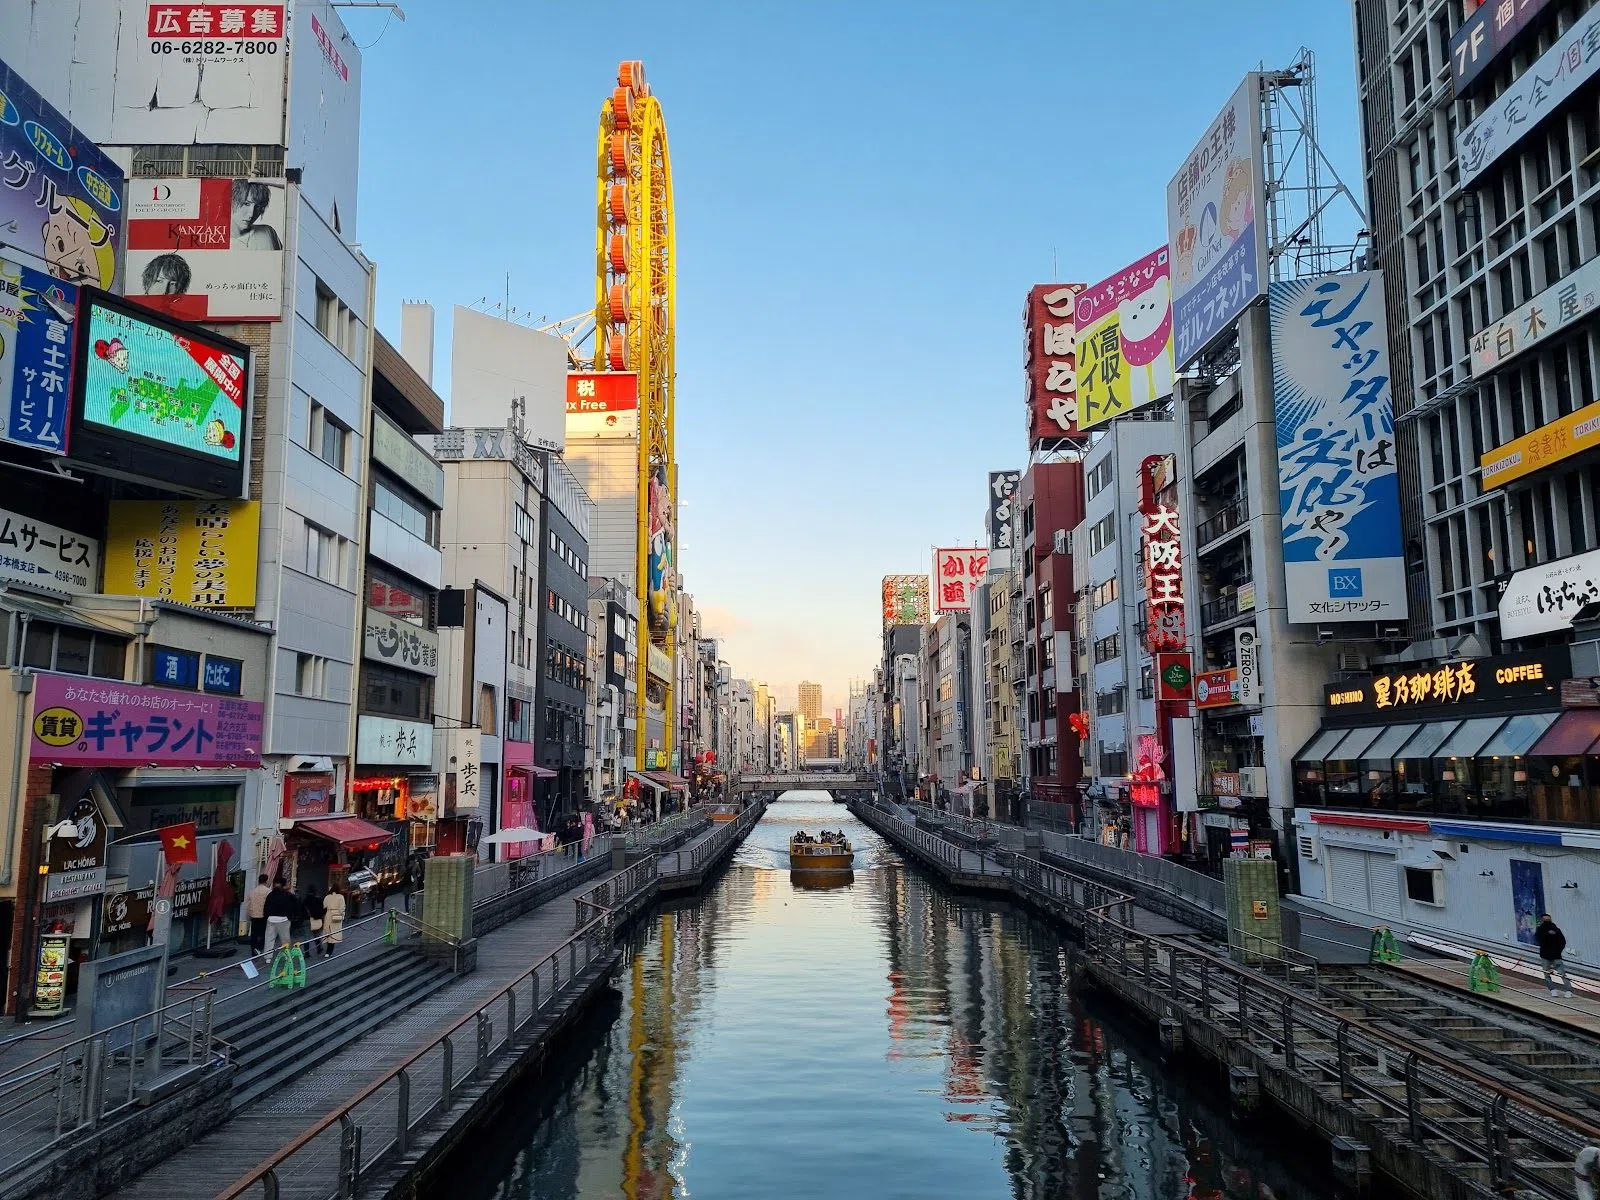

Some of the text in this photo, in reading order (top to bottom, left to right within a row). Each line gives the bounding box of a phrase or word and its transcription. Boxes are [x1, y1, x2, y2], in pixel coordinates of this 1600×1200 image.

[154, 9, 277, 34] 広告募集
[1496, 0, 1530, 31] 個
[151, 41, 278, 55] 06-6282-7800
[1455, 20, 1485, 76] 7F
[34, 126, 64, 167] リフォーム
[1177, 105, 1236, 205] 店舗の王様
[1092, 260, 1157, 307] いちごなび
[1178, 263, 1254, 359] ガルフネット
[1496, 283, 1582, 360] 白木屋
[1475, 331, 1490, 353] 4F
[36, 318, 69, 445] 富士ホーム
[577, 379, 596, 397] 税
[1080, 332, 1101, 423] バイト
[17, 366, 38, 433] サービス
[580, 399, 607, 411] Free
[943, 555, 989, 578] かに
[1146, 505, 1185, 643] 大阪王将
[943, 580, 976, 603] 道
[1333, 575, 1358, 591] BX
[1498, 580, 1508, 592] 2F
[1309, 600, 1390, 614] 文化シャッター
[165, 655, 179, 681] 酒
[205, 663, 231, 687] たばこ
[1495, 663, 1544, 685] COFFEE
[1373, 661, 1477, 709] 星乃珈琲店
[40, 714, 77, 738] 賃貸
[84, 708, 214, 754] ギャラント
[77, 740, 88, 753] の
[395, 726, 418, 759] 歩兵
[460, 761, 479, 798] 歩兵
